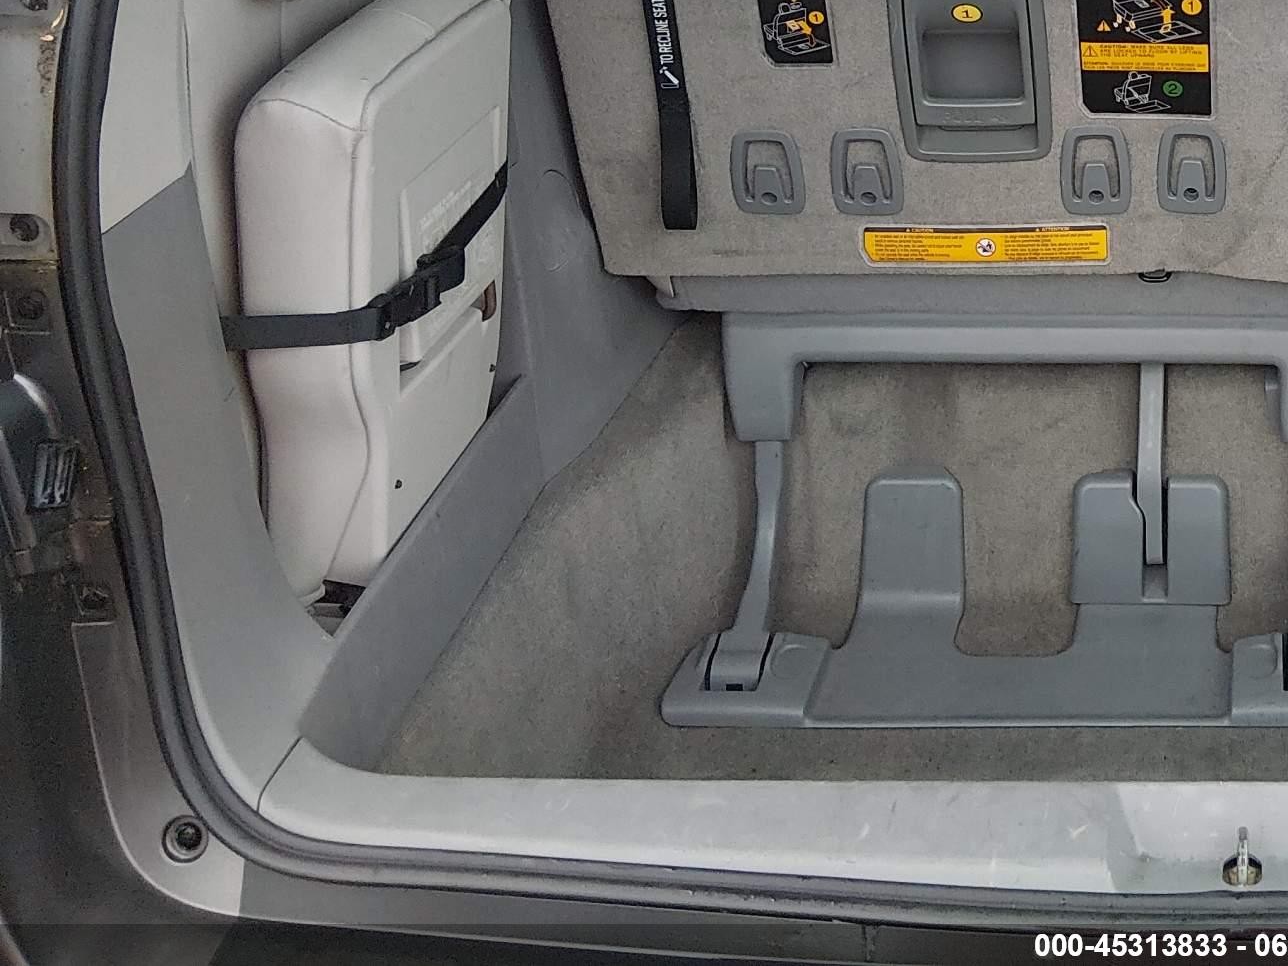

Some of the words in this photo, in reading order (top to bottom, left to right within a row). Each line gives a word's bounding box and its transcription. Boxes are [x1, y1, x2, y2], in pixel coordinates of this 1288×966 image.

[1187, 1, 1194, 13] 1
[961, 9, 973, 19] 1
[654, 19, 671, 52] RECLINE
[660, 52, 674, 65] TO
[1168, 83, 1178, 94] 2
